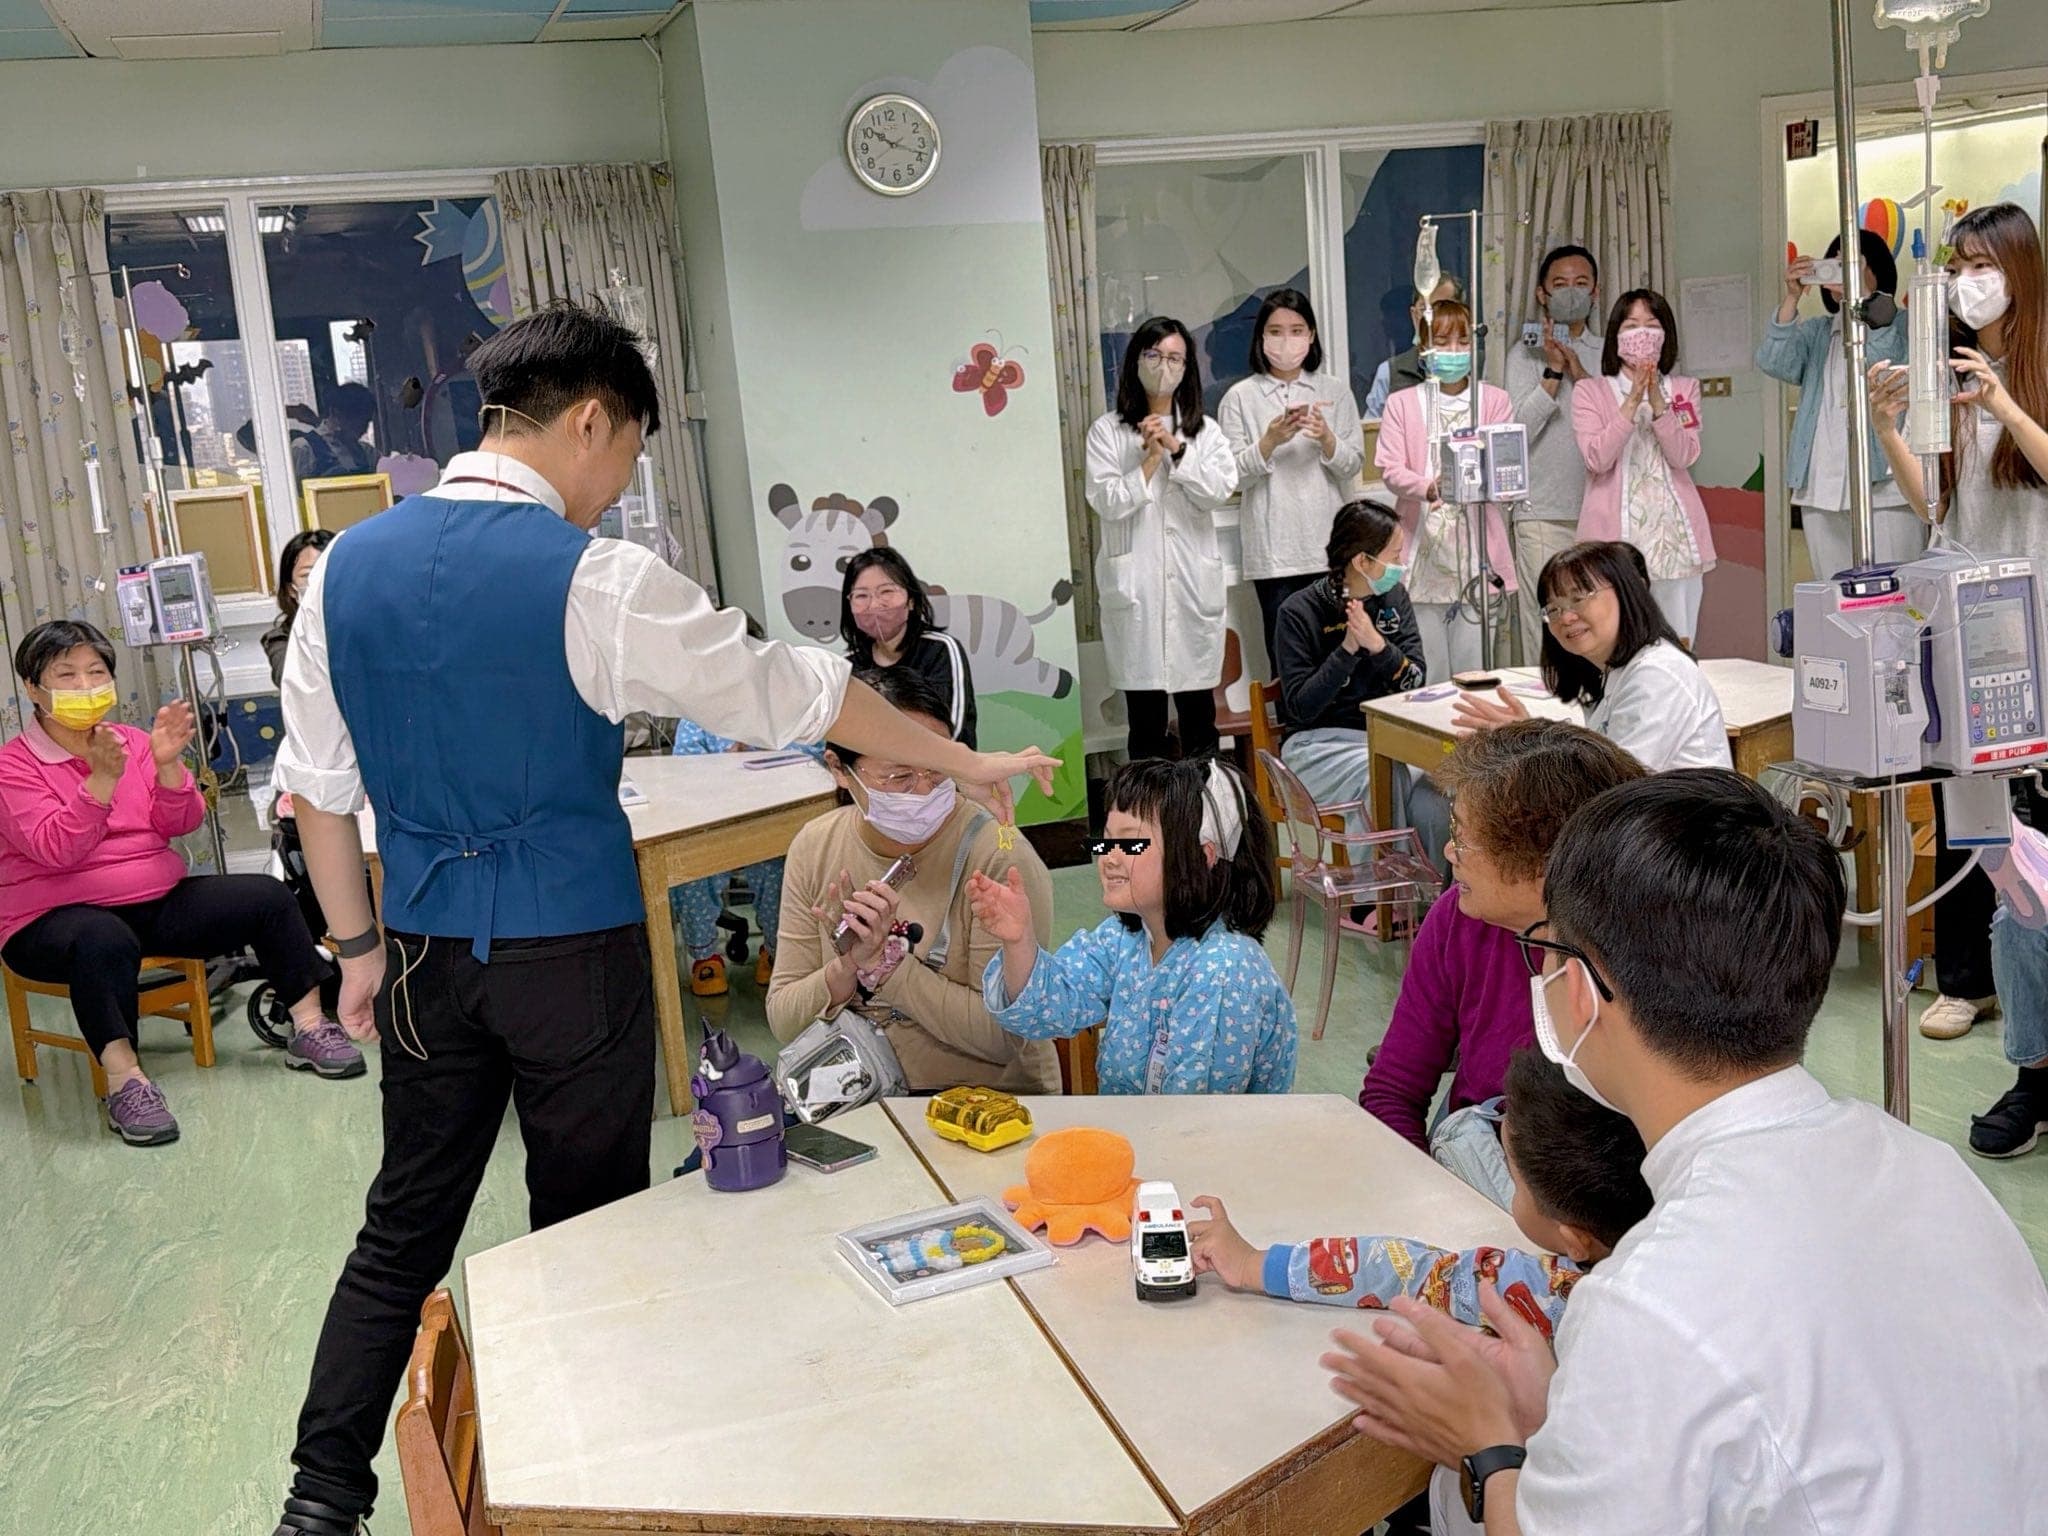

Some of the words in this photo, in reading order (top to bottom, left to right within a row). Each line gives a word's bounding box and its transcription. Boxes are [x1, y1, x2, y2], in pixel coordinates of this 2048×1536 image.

[871, 113, 880, 126] 11
[884, 110, 895, 121] 12
[902, 113, 907, 123] 1
[863, 127, 873, 139] 10
[912, 122, 919, 134] 2
[861, 143, 869, 154] 9
[918, 137, 926, 149] 3
[867, 157, 875, 169] 8
[916, 151, 923, 163] 4
[879, 167, 886, 178] 7
[893, 169, 901, 181] 6
[907, 164, 915, 175] 5
[1809, 676, 1838, 690] A092-7
[2009, 746, 2032, 757] PUMP
